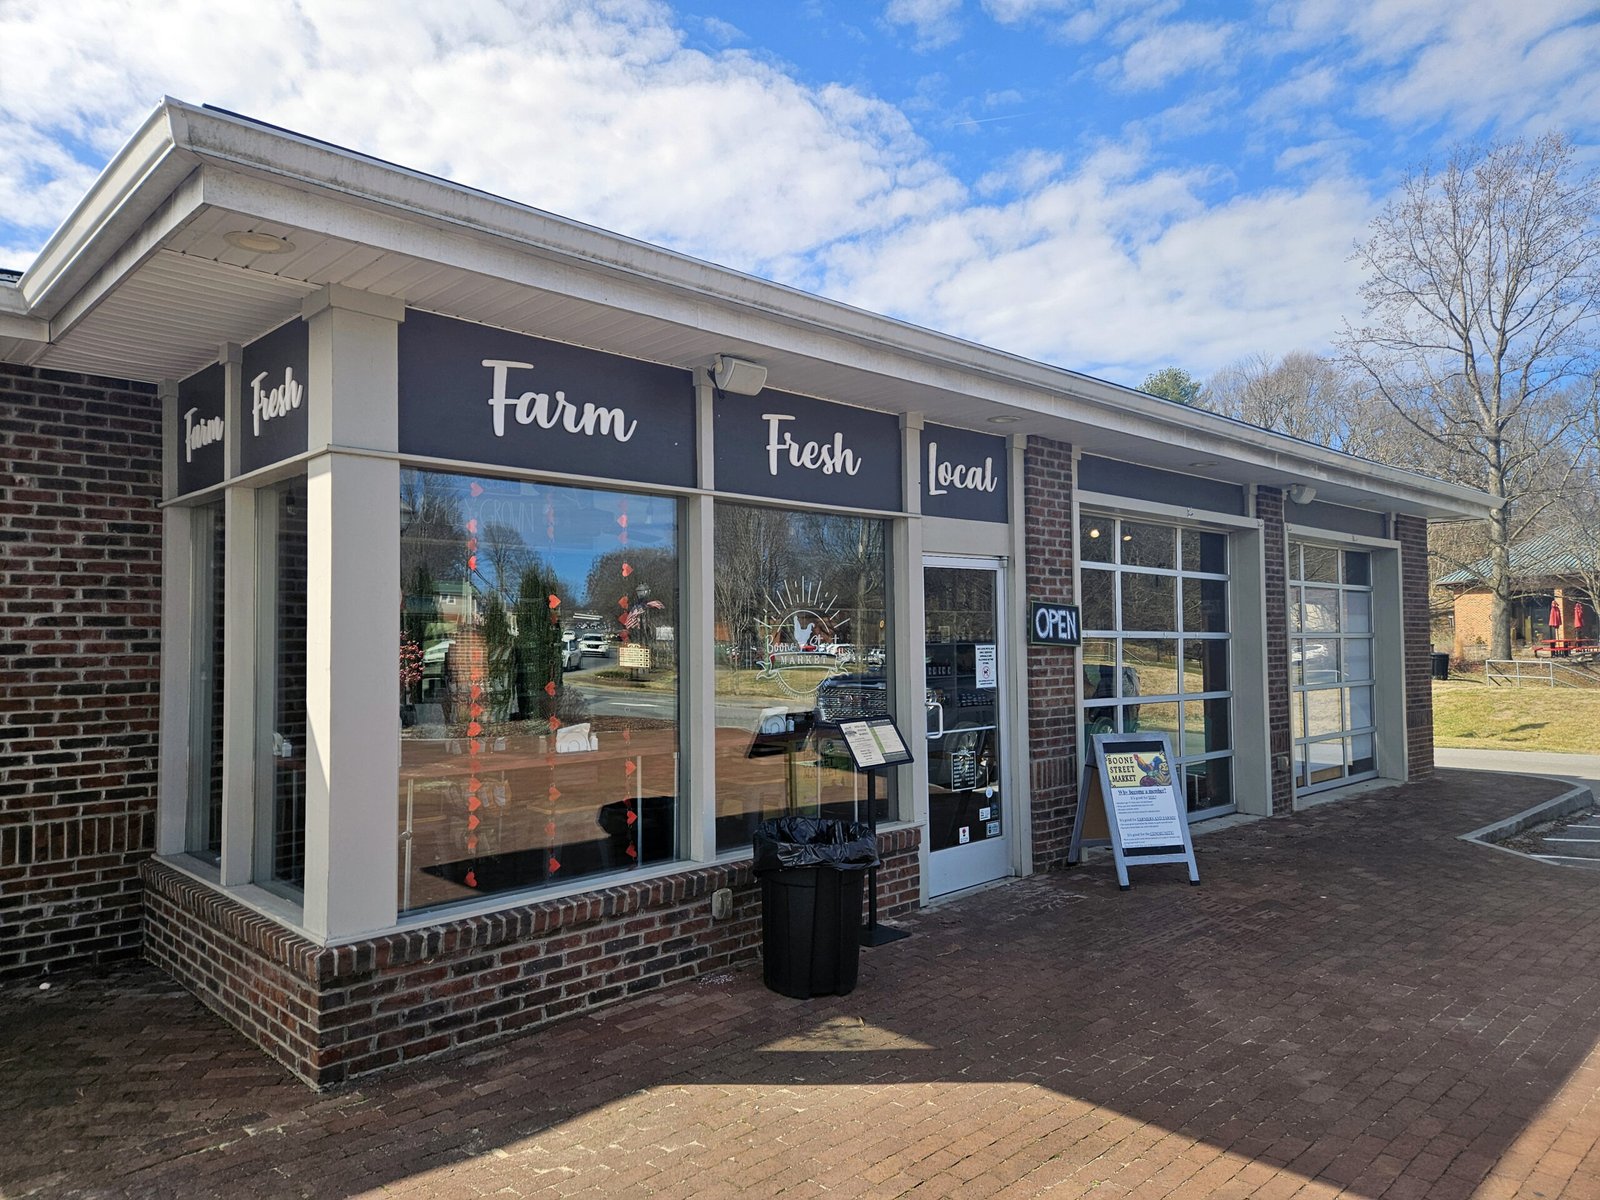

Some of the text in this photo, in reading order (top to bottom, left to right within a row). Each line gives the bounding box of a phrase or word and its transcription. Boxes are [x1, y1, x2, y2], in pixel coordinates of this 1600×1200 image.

[250, 366, 304, 437] Fresh
[481, 359, 638, 442] Farm
[184, 407, 224, 463] Farm
[761, 413, 862, 476] Fresh
[928, 442, 998, 496] Local
[479, 498, 535, 533] GROWN
[1035, 607, 1077, 640] OPEN
[766, 635, 796, 654] Boone
[780, 655, 828, 665] MARKET
[1107, 756, 1134, 765] BOONE
[1109, 766, 1135, 774] STREET
[1111, 775, 1137, 783] MARKET
